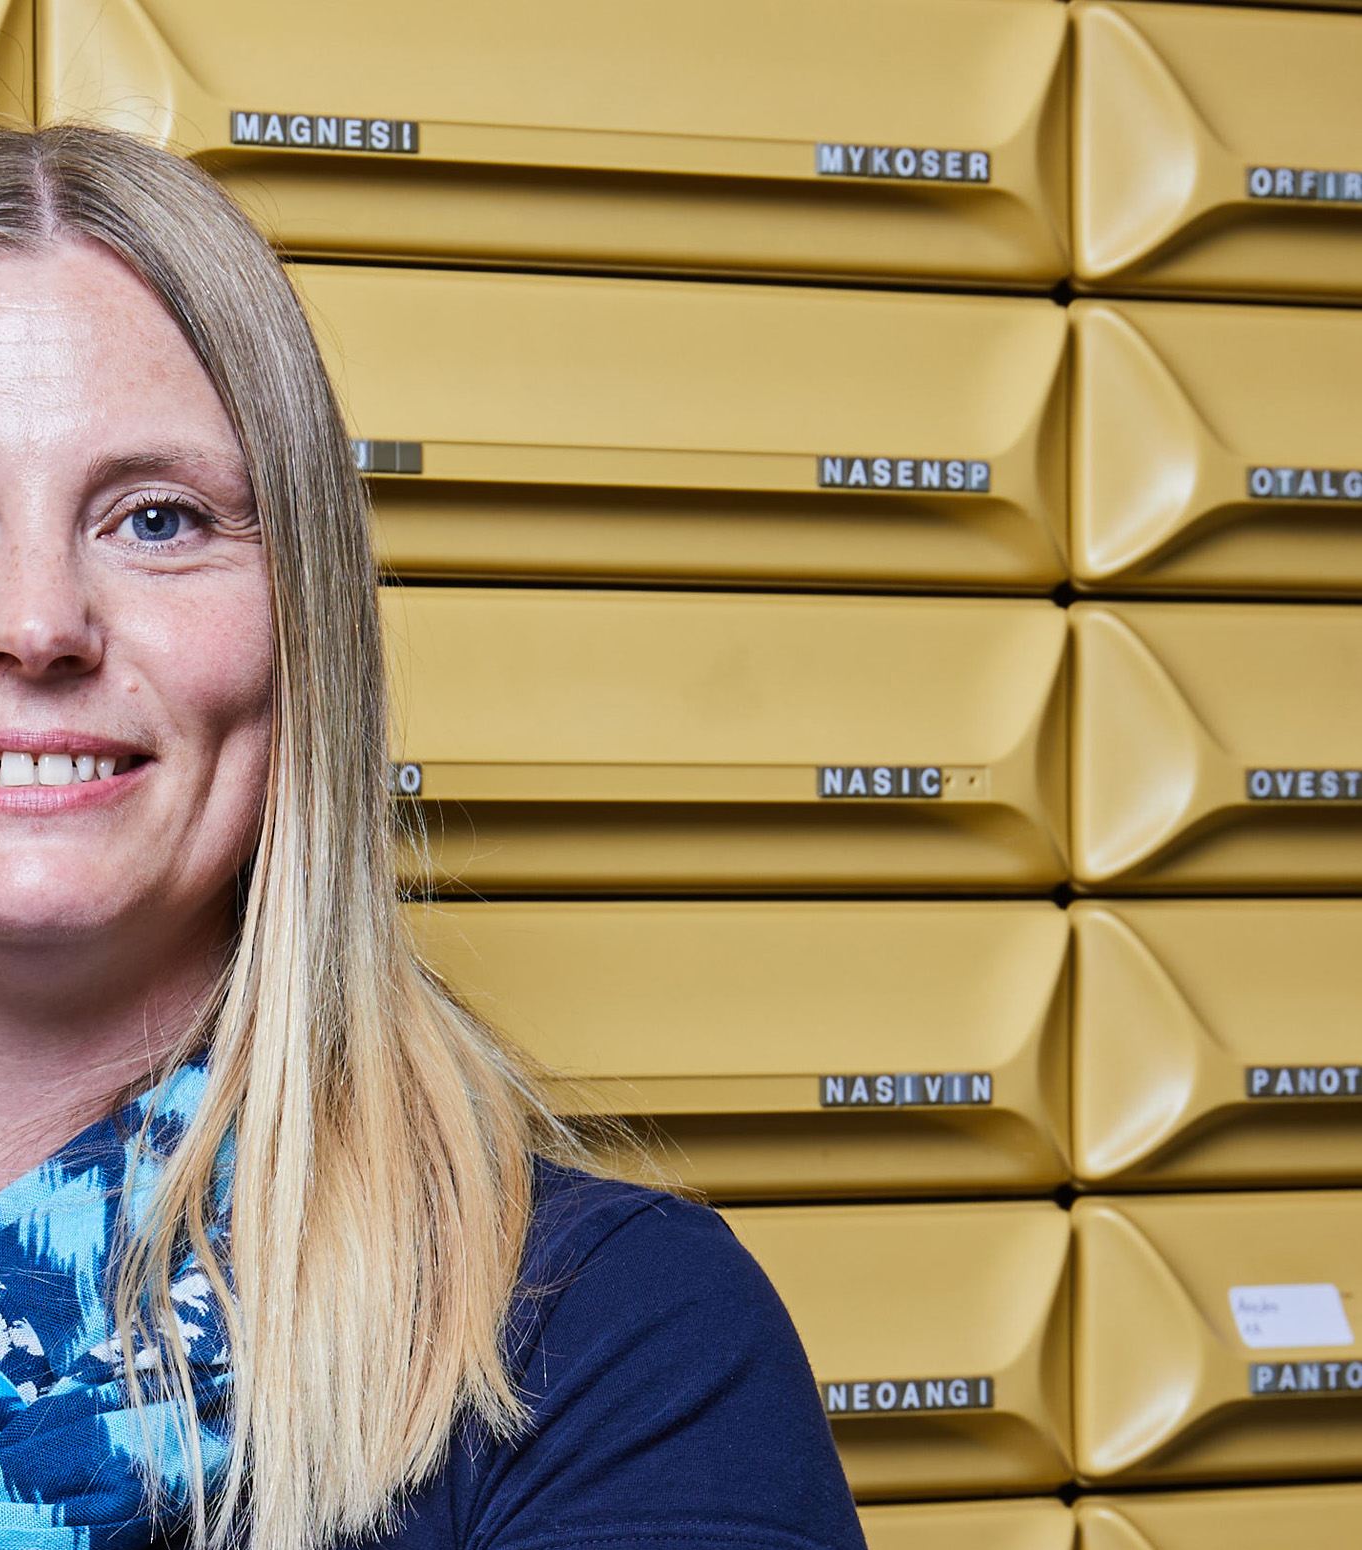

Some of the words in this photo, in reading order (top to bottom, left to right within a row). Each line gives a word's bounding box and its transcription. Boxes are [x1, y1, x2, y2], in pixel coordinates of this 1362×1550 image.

[236, 113, 411, 149] MAGNESI
[817, 144, 988, 179] MYKOSER
[824, 458, 988, 488] NASENSP
[824, 767, 939, 795] NASIC
[826, 1075, 990, 1103] NASIVIN
[1253, 1067, 1361, 1094] PANOT
[1256, 1362, 1362, 1391] PANTO
[828, 1379, 987, 1410] NEOANGI
